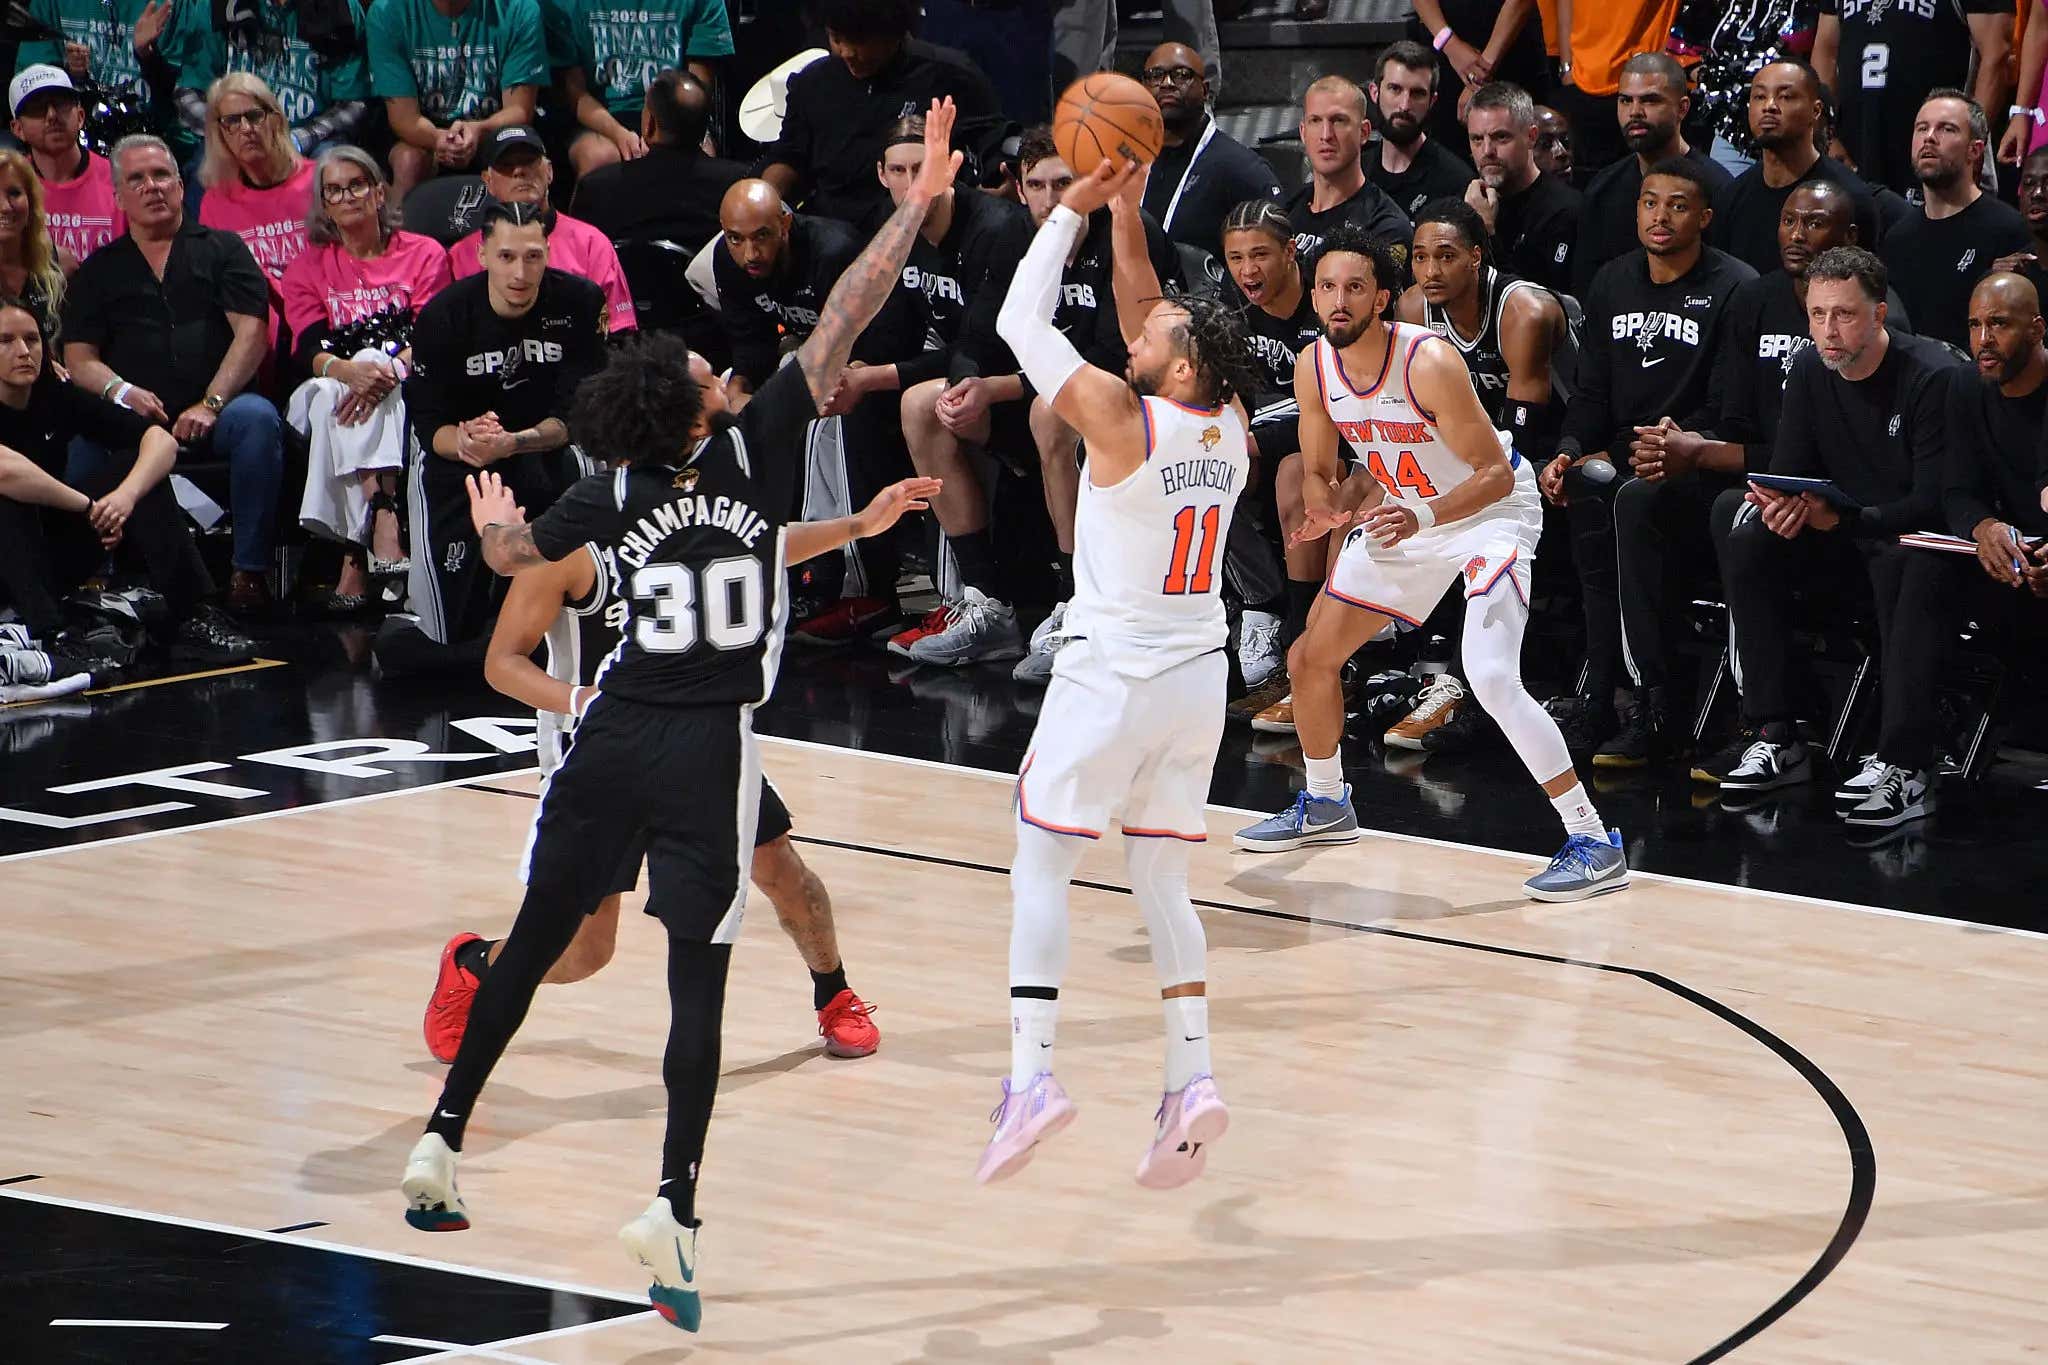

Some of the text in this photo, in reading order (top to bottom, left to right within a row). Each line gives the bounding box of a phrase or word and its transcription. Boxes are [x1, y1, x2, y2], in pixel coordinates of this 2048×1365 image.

[610, 10, 648, 23] 2026
[438, 44, 471, 60] 206
[1862, 43, 1890, 88] 2
[278, 87, 315, 122] GO
[256, 219, 293, 237] 2026
[354, 286, 389, 300] 2026
[1612, 312, 1699, 351] SPURS
[466, 338, 563, 380] SPURS
[1759, 334, 1815, 374] SPU
[1371, 419, 1434, 444] YORK
[1161, 459, 1237, 495] BRUNSON
[1367, 450, 1440, 498] 44
[618, 494, 769, 569] CHAMPAGNIE
[1162, 504, 1221, 595] 11
[630, 554, 765, 654] 30
